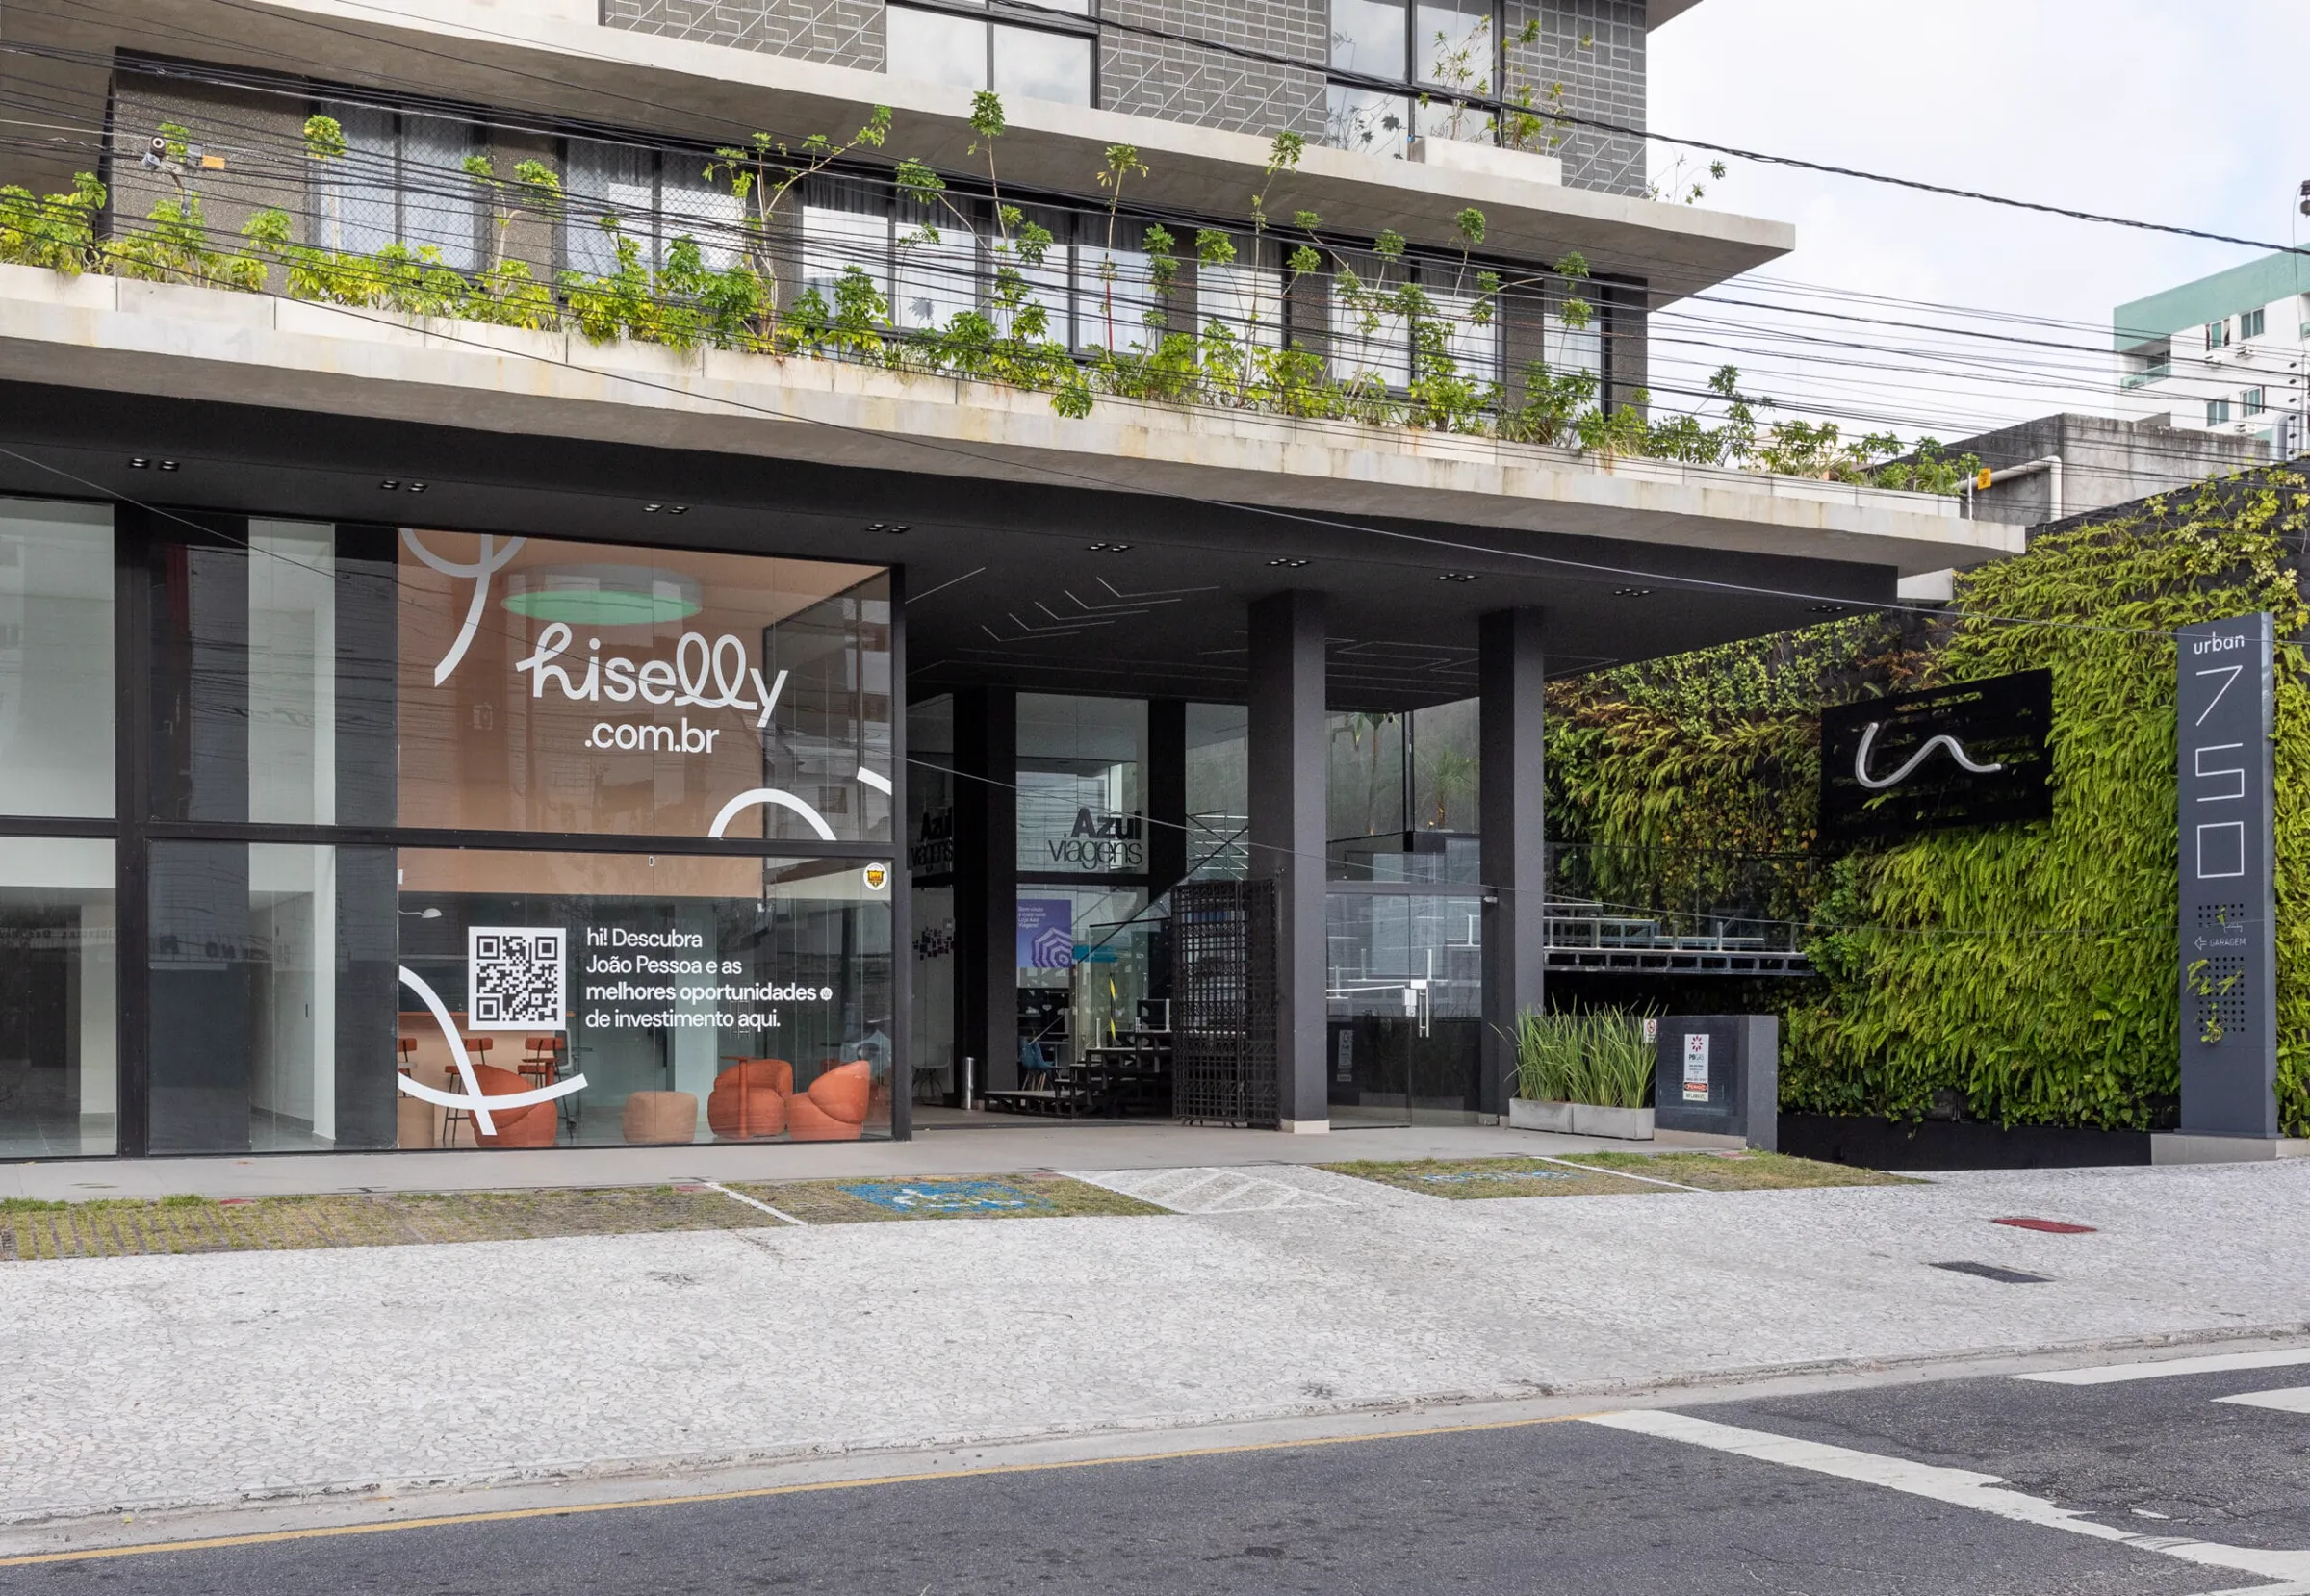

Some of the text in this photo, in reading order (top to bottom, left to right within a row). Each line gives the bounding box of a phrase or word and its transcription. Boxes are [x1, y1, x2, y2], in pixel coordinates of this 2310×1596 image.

[2194, 631, 2245, 655] urban
[515, 622, 788, 728] hiselly
[584, 717, 720, 754] .com.br
[1070, 807, 1142, 840] Azul
[1048, 833, 1142, 870] viagens
[586, 927, 704, 948] hi! Descubra
[2209, 938, 2246, 947] GARAGEM
[585, 954, 742, 975] João Pessoa e as
[585, 981, 817, 1006] melhores oportunidades
[585, 1009, 781, 1032] de investimento aqui.
